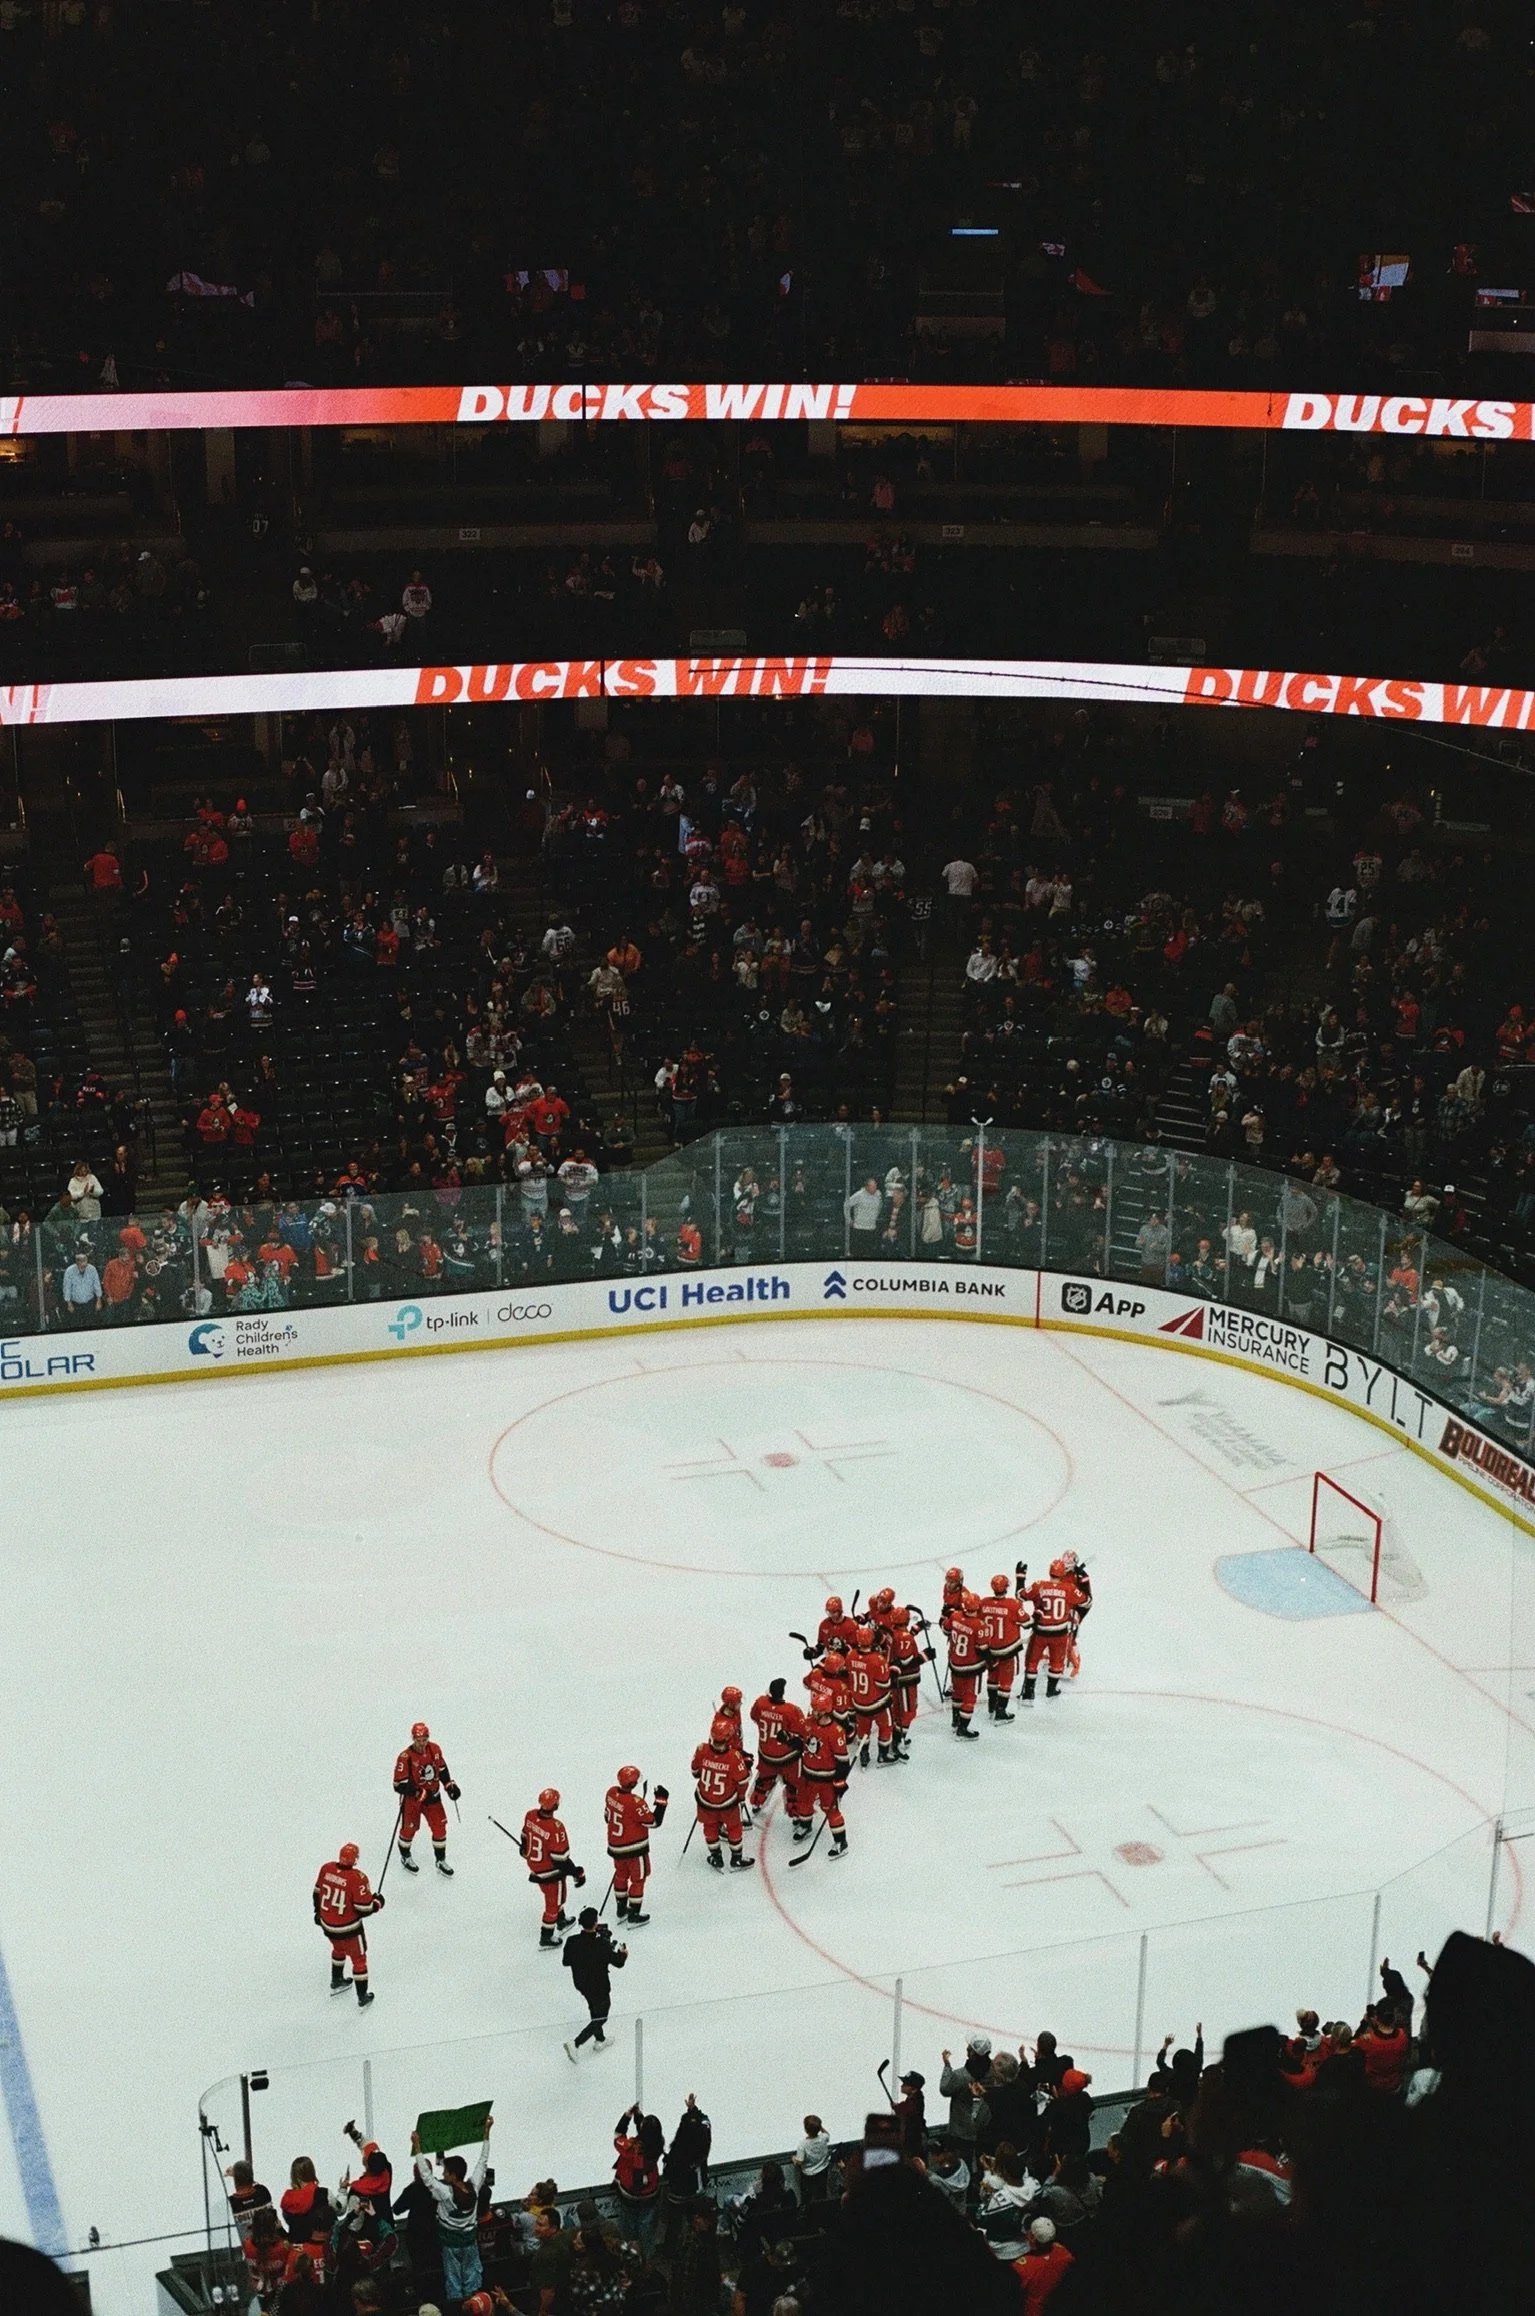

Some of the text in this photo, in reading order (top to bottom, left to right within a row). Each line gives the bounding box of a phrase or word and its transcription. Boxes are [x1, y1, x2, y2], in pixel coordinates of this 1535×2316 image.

[457, 384, 857, 421] DUCKS WIN!
[1282, 393, 1516, 439] DUCKS
[462, 530, 477, 538] 322
[415, 657, 834, 704] DUCKS WIN!
[1182, 667, 1535, 731] DUCKS WI
[1360, 862, 1376, 876] 25
[612, 1000, 631, 1016] 46
[608, 1275, 791, 1314] UCI Health
[853, 1277, 1006, 1298] COLUMBIA BANK
[497, 1302, 552, 1322] deco
[235, 1319, 269, 1332] Rady
[1209, 1306, 1311, 1355] MERCURY
[237, 1343, 280, 1357] Health
[1207, 1328, 1310, 1375] INSURANCE
[1324, 1341, 1434, 1440] BYLT
[900, 1640, 911, 1650] 17
[851, 1671, 869, 1695] 19
[836, 1695, 848, 1706] 91
[760, 1719, 783, 1745] 34
[701, 1767, 727, 1796] 45
[636, 1803, 650, 1817] 25
[526, 1831, 543, 1862] 13
[555, 1831, 566, 1843] 13
[320, 1883, 346, 1916] 24
